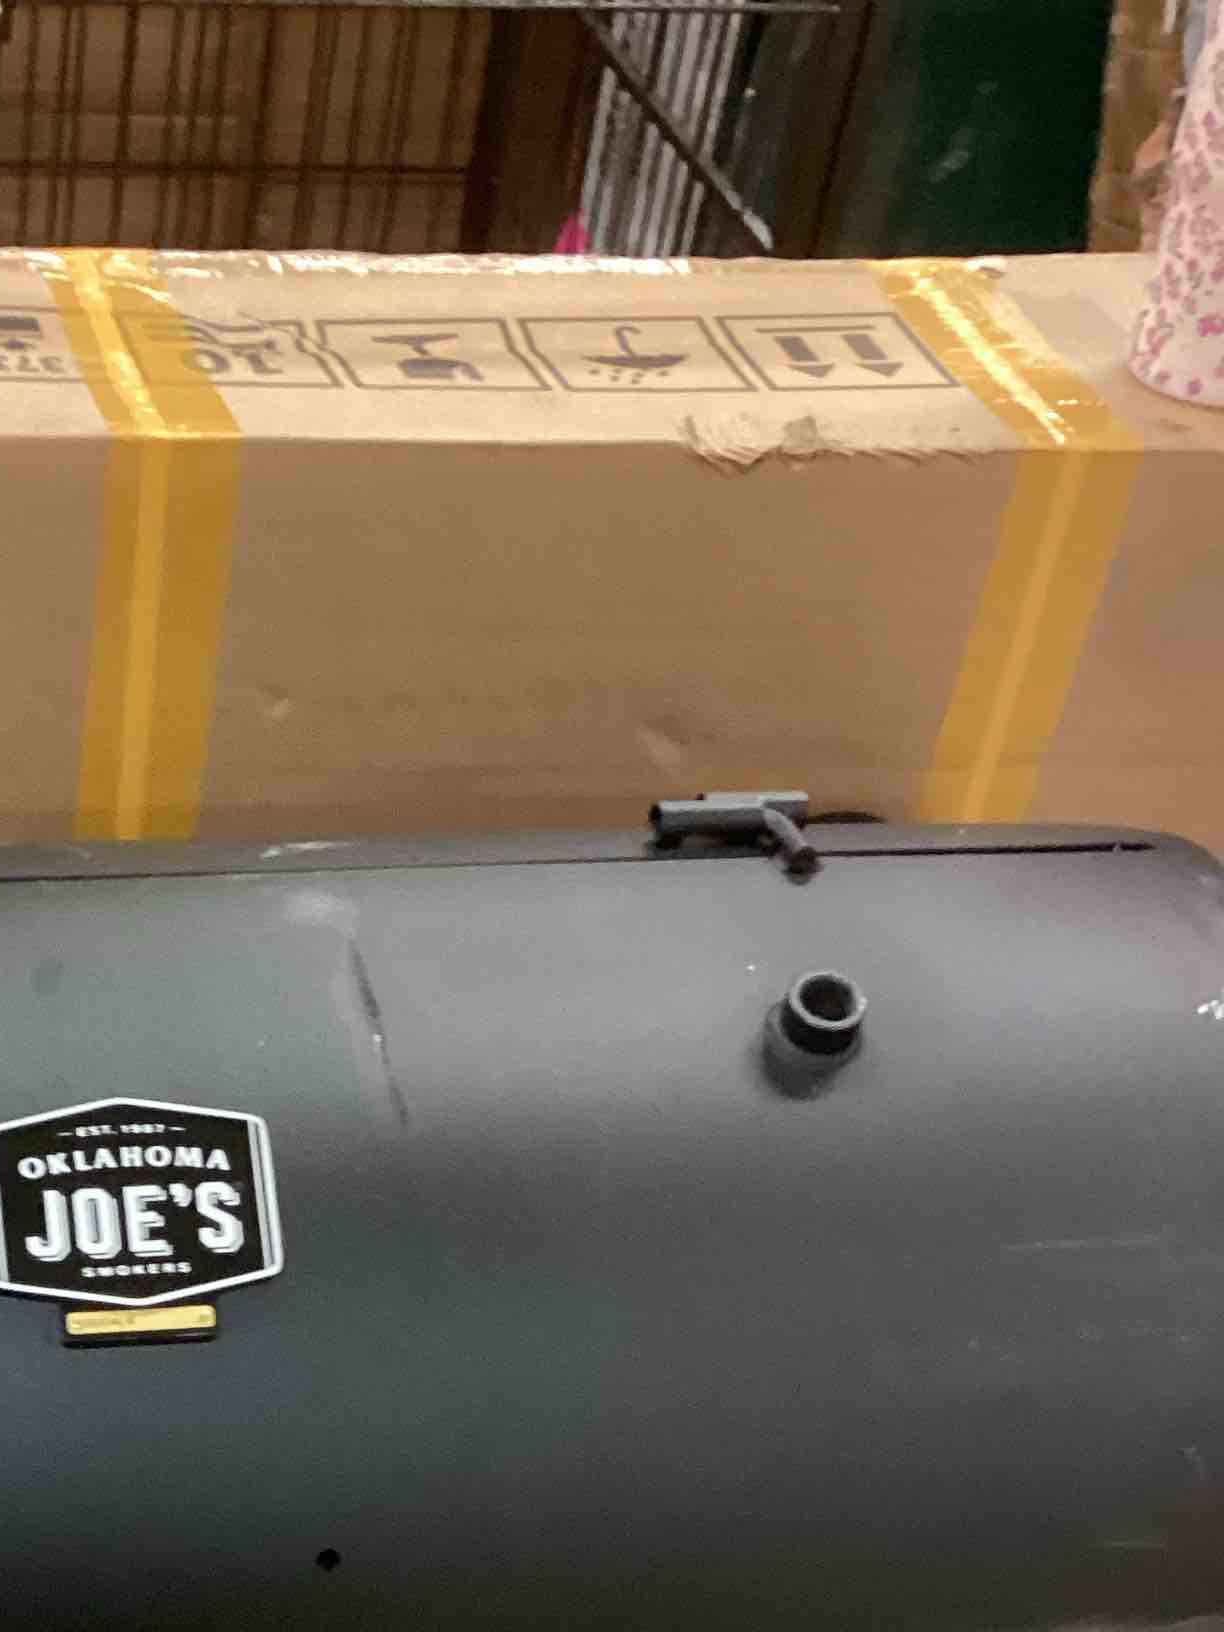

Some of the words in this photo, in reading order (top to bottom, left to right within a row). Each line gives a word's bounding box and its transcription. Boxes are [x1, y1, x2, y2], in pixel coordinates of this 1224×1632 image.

[17, 1145, 231, 1180] OKLAHOMA
[24, 1180, 245, 1262] JOE'S
[80, 1261, 193, 1278] SMOKERS
